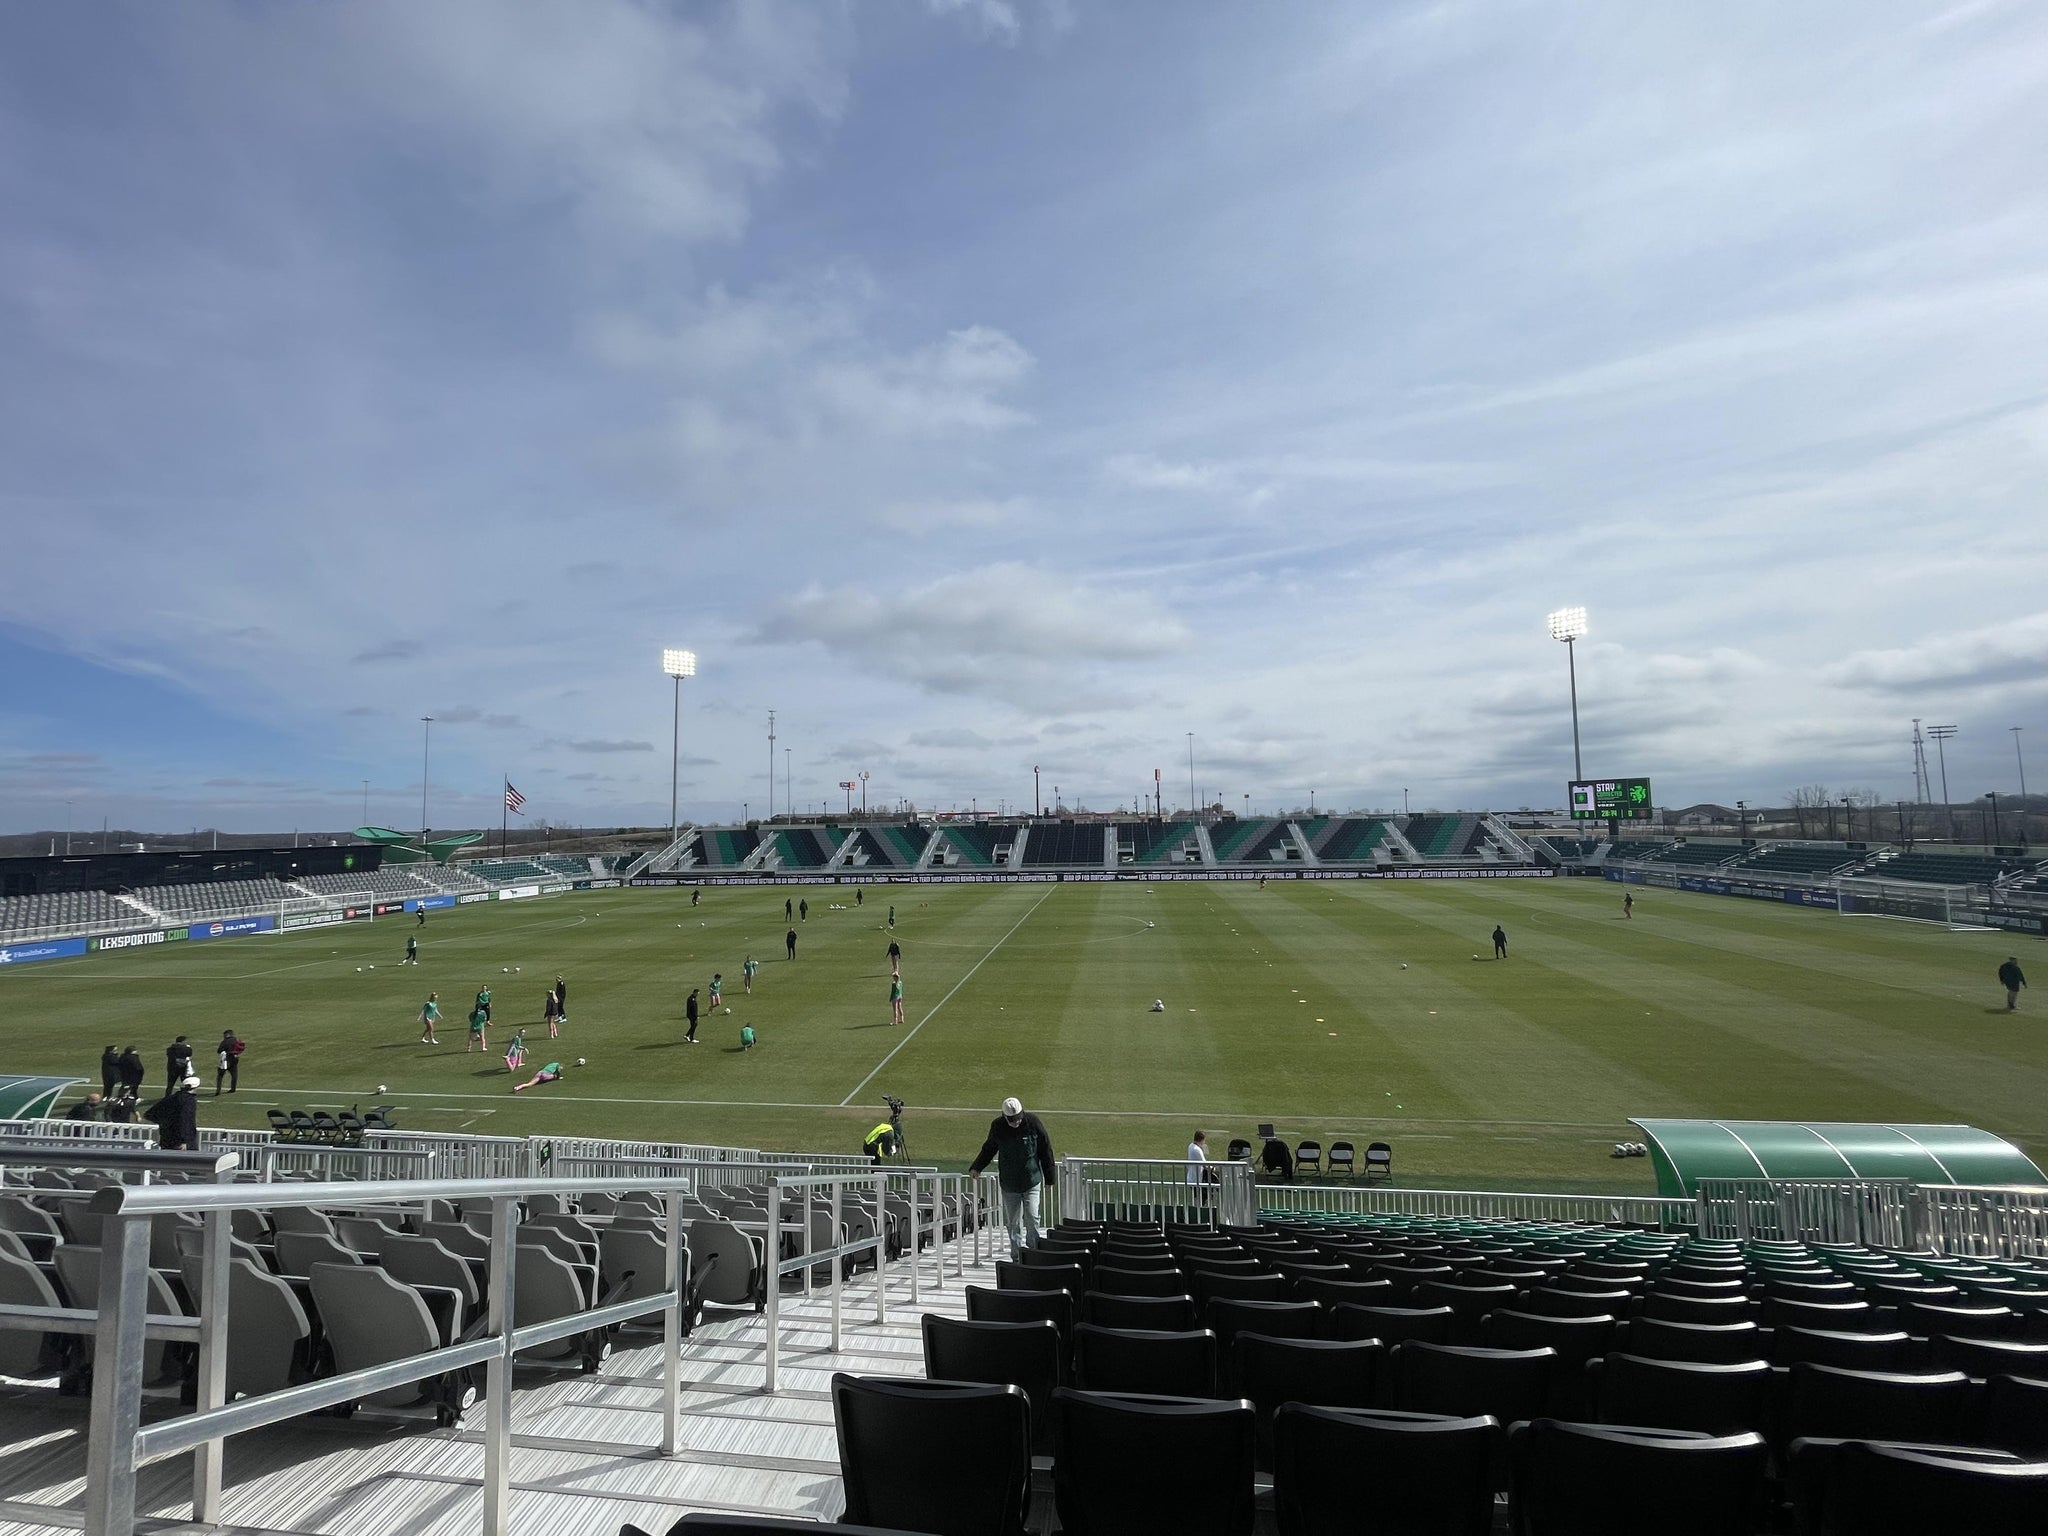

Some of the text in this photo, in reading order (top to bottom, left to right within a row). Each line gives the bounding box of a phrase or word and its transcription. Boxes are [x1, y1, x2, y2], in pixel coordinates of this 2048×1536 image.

[1596, 784, 1615, 792] STAY
[100, 928, 188, 950] LEXSPORTING.COM
[14, 948, 57, 958] HealthCare
